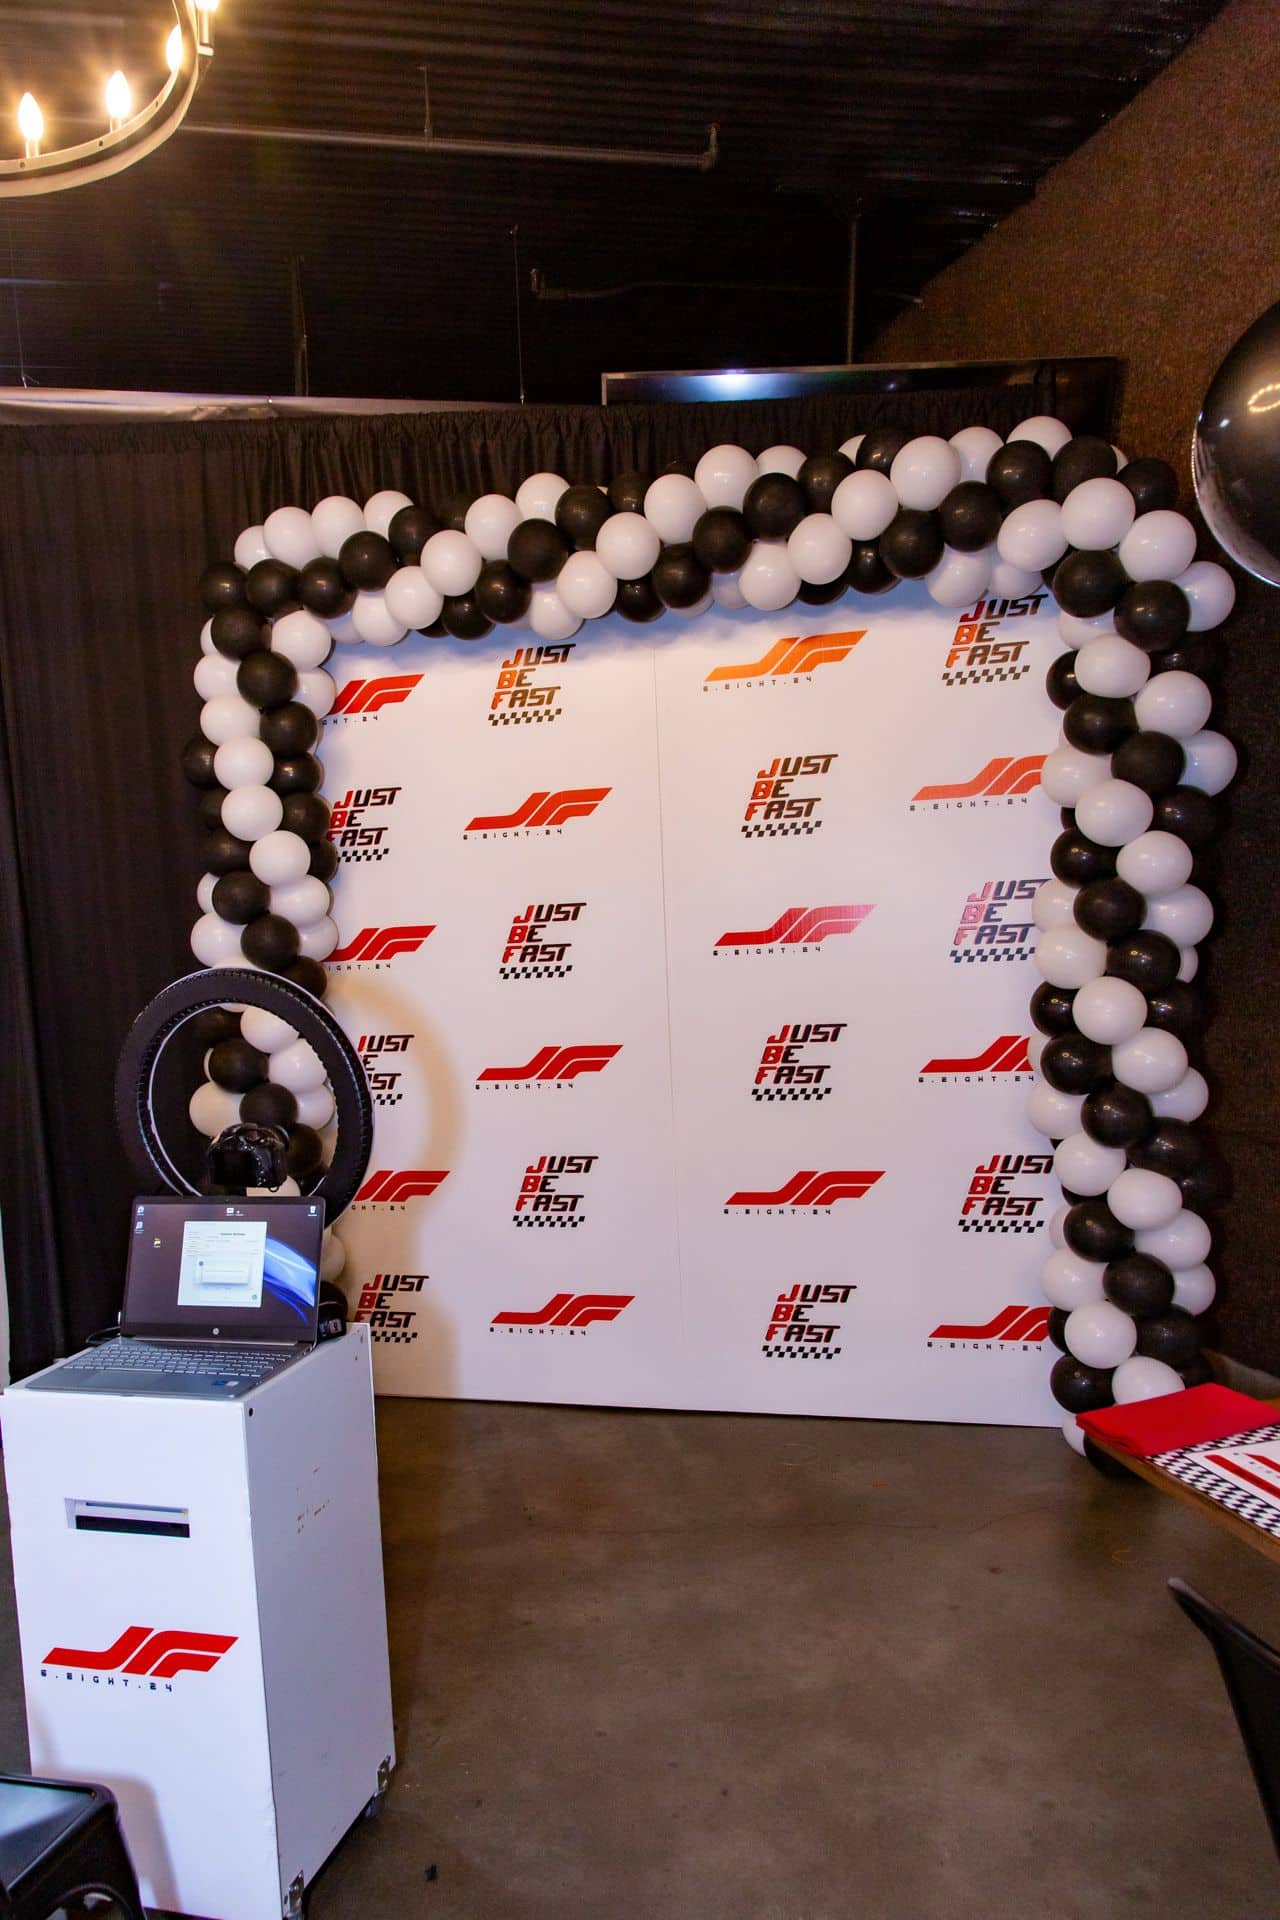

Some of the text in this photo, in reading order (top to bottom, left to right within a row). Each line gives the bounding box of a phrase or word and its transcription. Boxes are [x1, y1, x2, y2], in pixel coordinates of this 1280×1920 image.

[960, 594, 1048, 622] JUST
[952, 621, 1000, 645] BE
[502, 643, 576, 668] JUST
[945, 641, 1030, 668] FAST
[497, 668, 537, 690] BE
[491, 686, 562, 710] FAST
[757, 754, 839, 778] JUST
[334, 787, 402, 809] JUST
[751, 778, 795, 800] BE
[330, 809, 365, 828] BE
[744, 797, 822, 822] FAST
[326, 827, 388, 848] FAST
[513, 903, 587, 924] JUST
[960, 902, 1007, 924] BE
[508, 924, 547, 944] BE
[953, 923, 1036, 946] FAST
[501, 943, 572, 964] FAST
[766, 1023, 848, 1044] JUST
[760, 1044, 804, 1064] BE
[754, 1065, 831, 1085] FAST
[525, 1155, 599, 1174] JUST
[975, 1154, 1054, 1174] JUST
[520, 1175, 560, 1193] BE
[968, 1175, 1015, 1195] BE
[515, 1194, 585, 1212] FAST
[961, 1196, 1044, 1216] FAST
[362, 1274, 430, 1292] JUST
[777, 1284, 857, 1303] JUST
[358, 1292, 394, 1309] BE
[771, 1304, 815, 1323] BE
[765, 1324, 841, 1343] FAST
